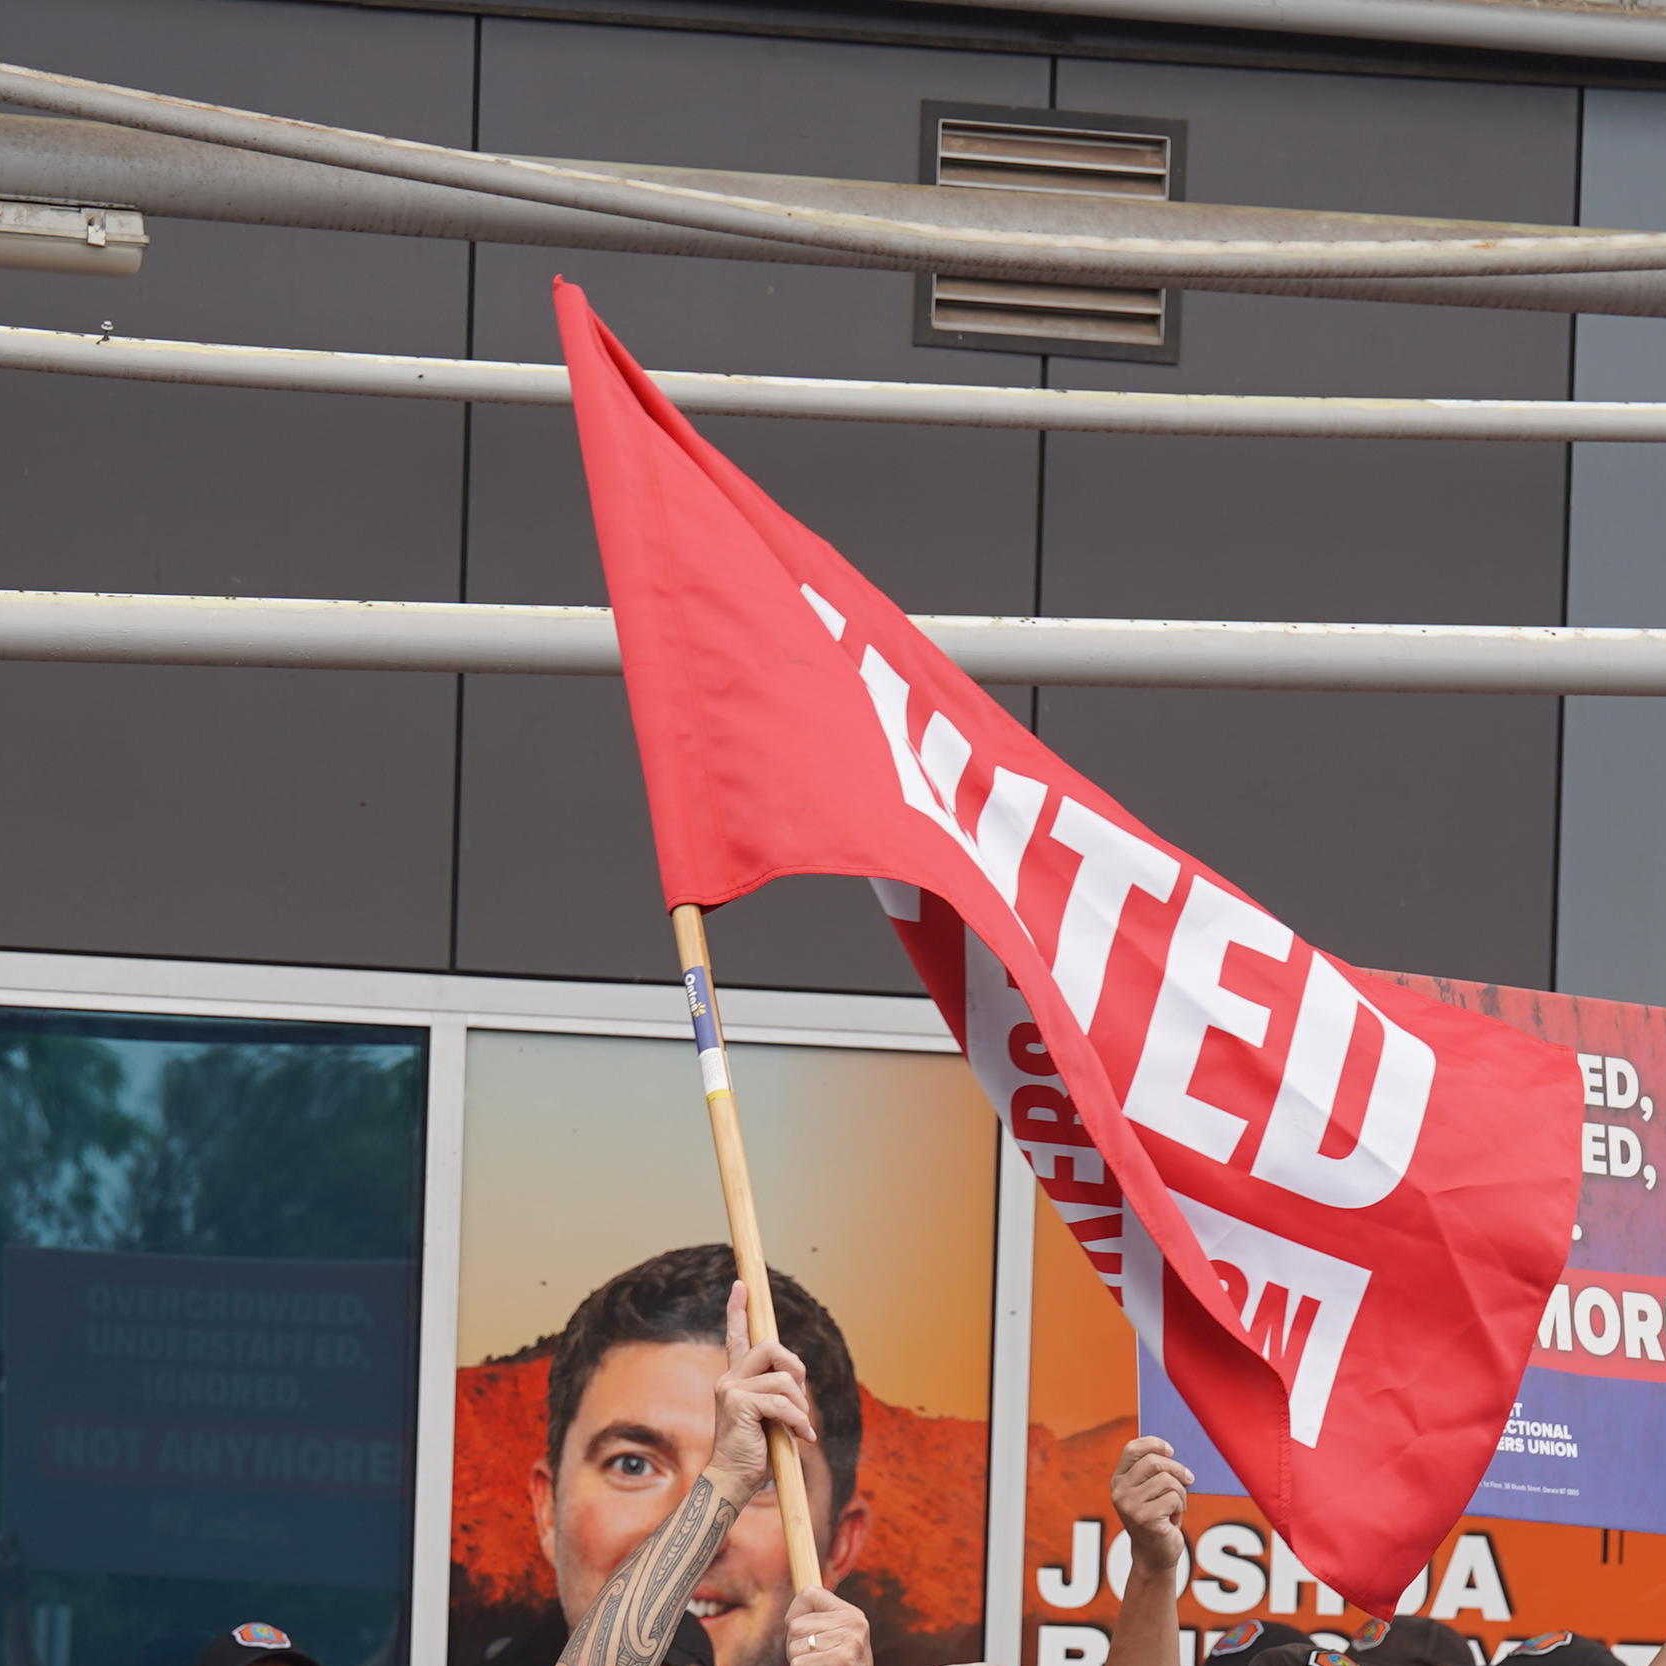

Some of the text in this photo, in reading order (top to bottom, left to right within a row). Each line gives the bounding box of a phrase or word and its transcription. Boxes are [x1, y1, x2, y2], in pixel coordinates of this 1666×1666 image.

[1503, 1419, 1572, 1440] CTIONAL
[53, 1425, 145, 1469] NOT
[1528, 1439, 1578, 1458] UNION
